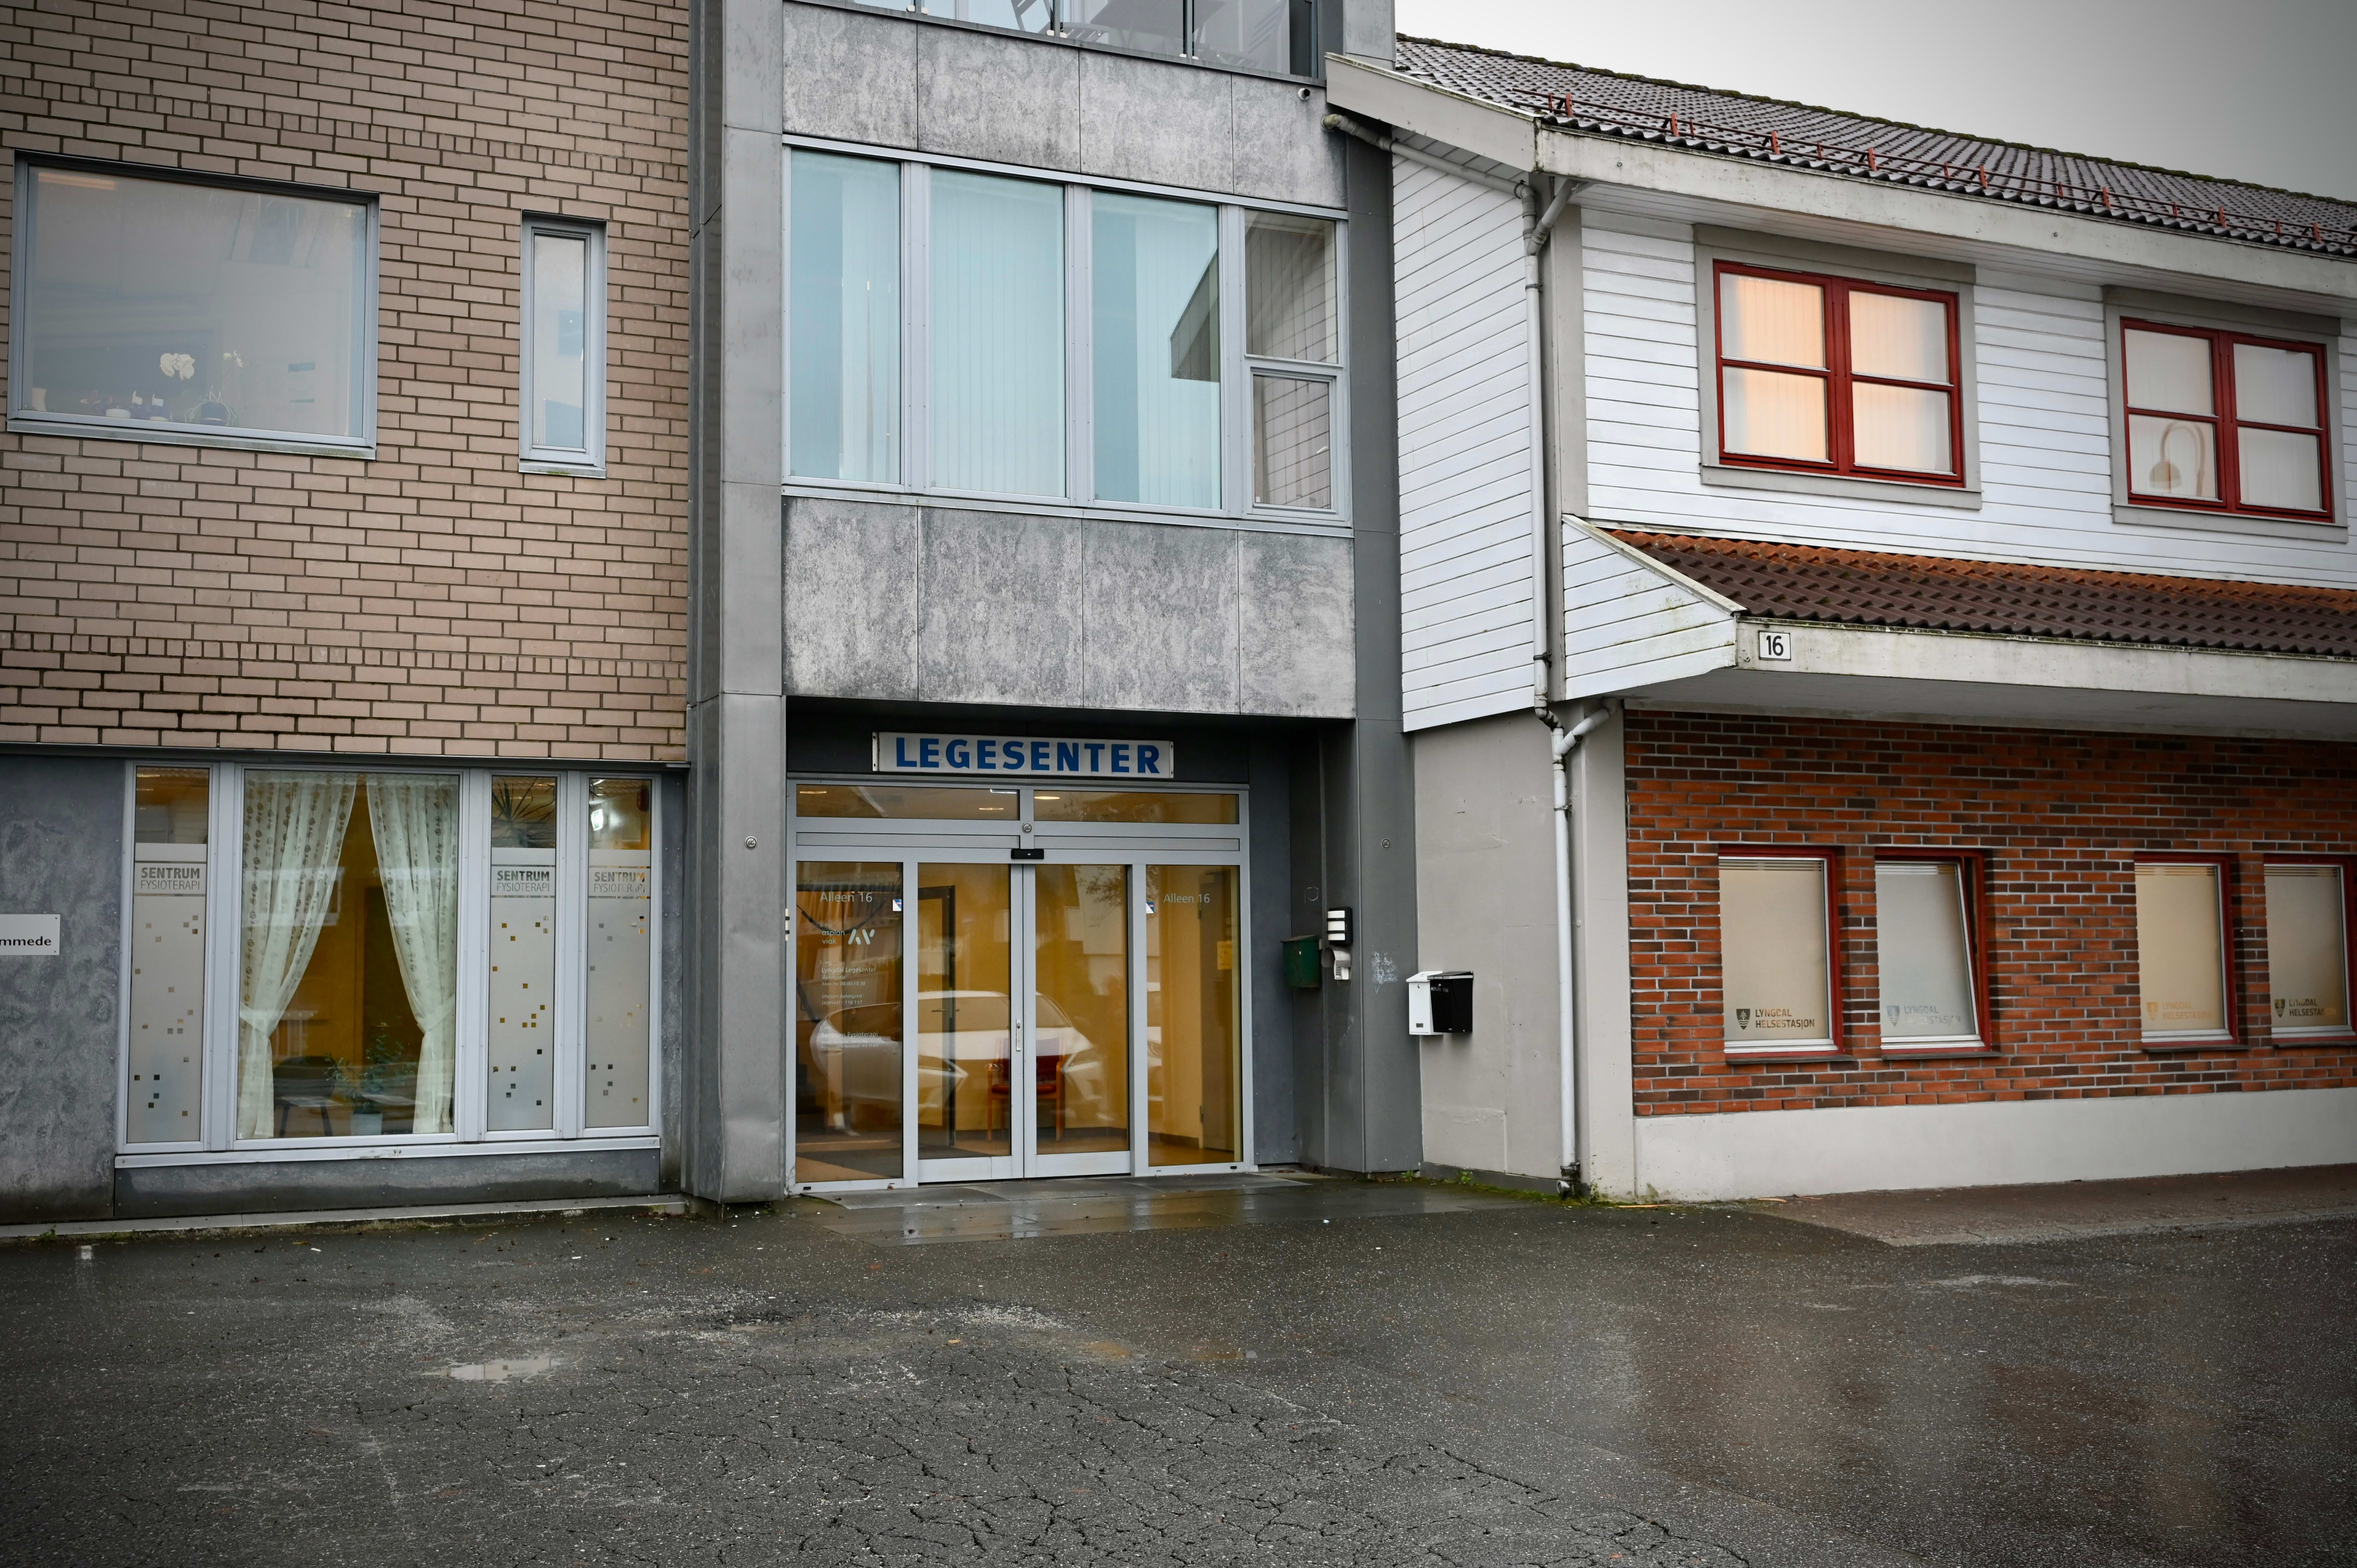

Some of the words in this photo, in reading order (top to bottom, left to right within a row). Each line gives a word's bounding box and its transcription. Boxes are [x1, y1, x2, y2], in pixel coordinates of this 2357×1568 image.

[1766, 635, 1784, 656] 16
[896, 737, 1160, 773] LEGESENTER
[141, 867, 200, 879] SENTRUM
[497, 870, 549, 881] SENTRUM
[141, 880, 200, 890] FYSIOTERAPI
[497, 882, 549, 892] FYSIOTERAPI
[820, 892, 854, 902] Alleen
[859, 892, 872, 902] 16
[1164, 893, 1194, 903] Alleen
[1199, 894, 1210, 903] 16
[0, 936, 51, 946] mmede
[1755, 1009, 1792, 1017] LYNGDAL
[1756, 1019, 1815, 1030] HELSESTASJON
